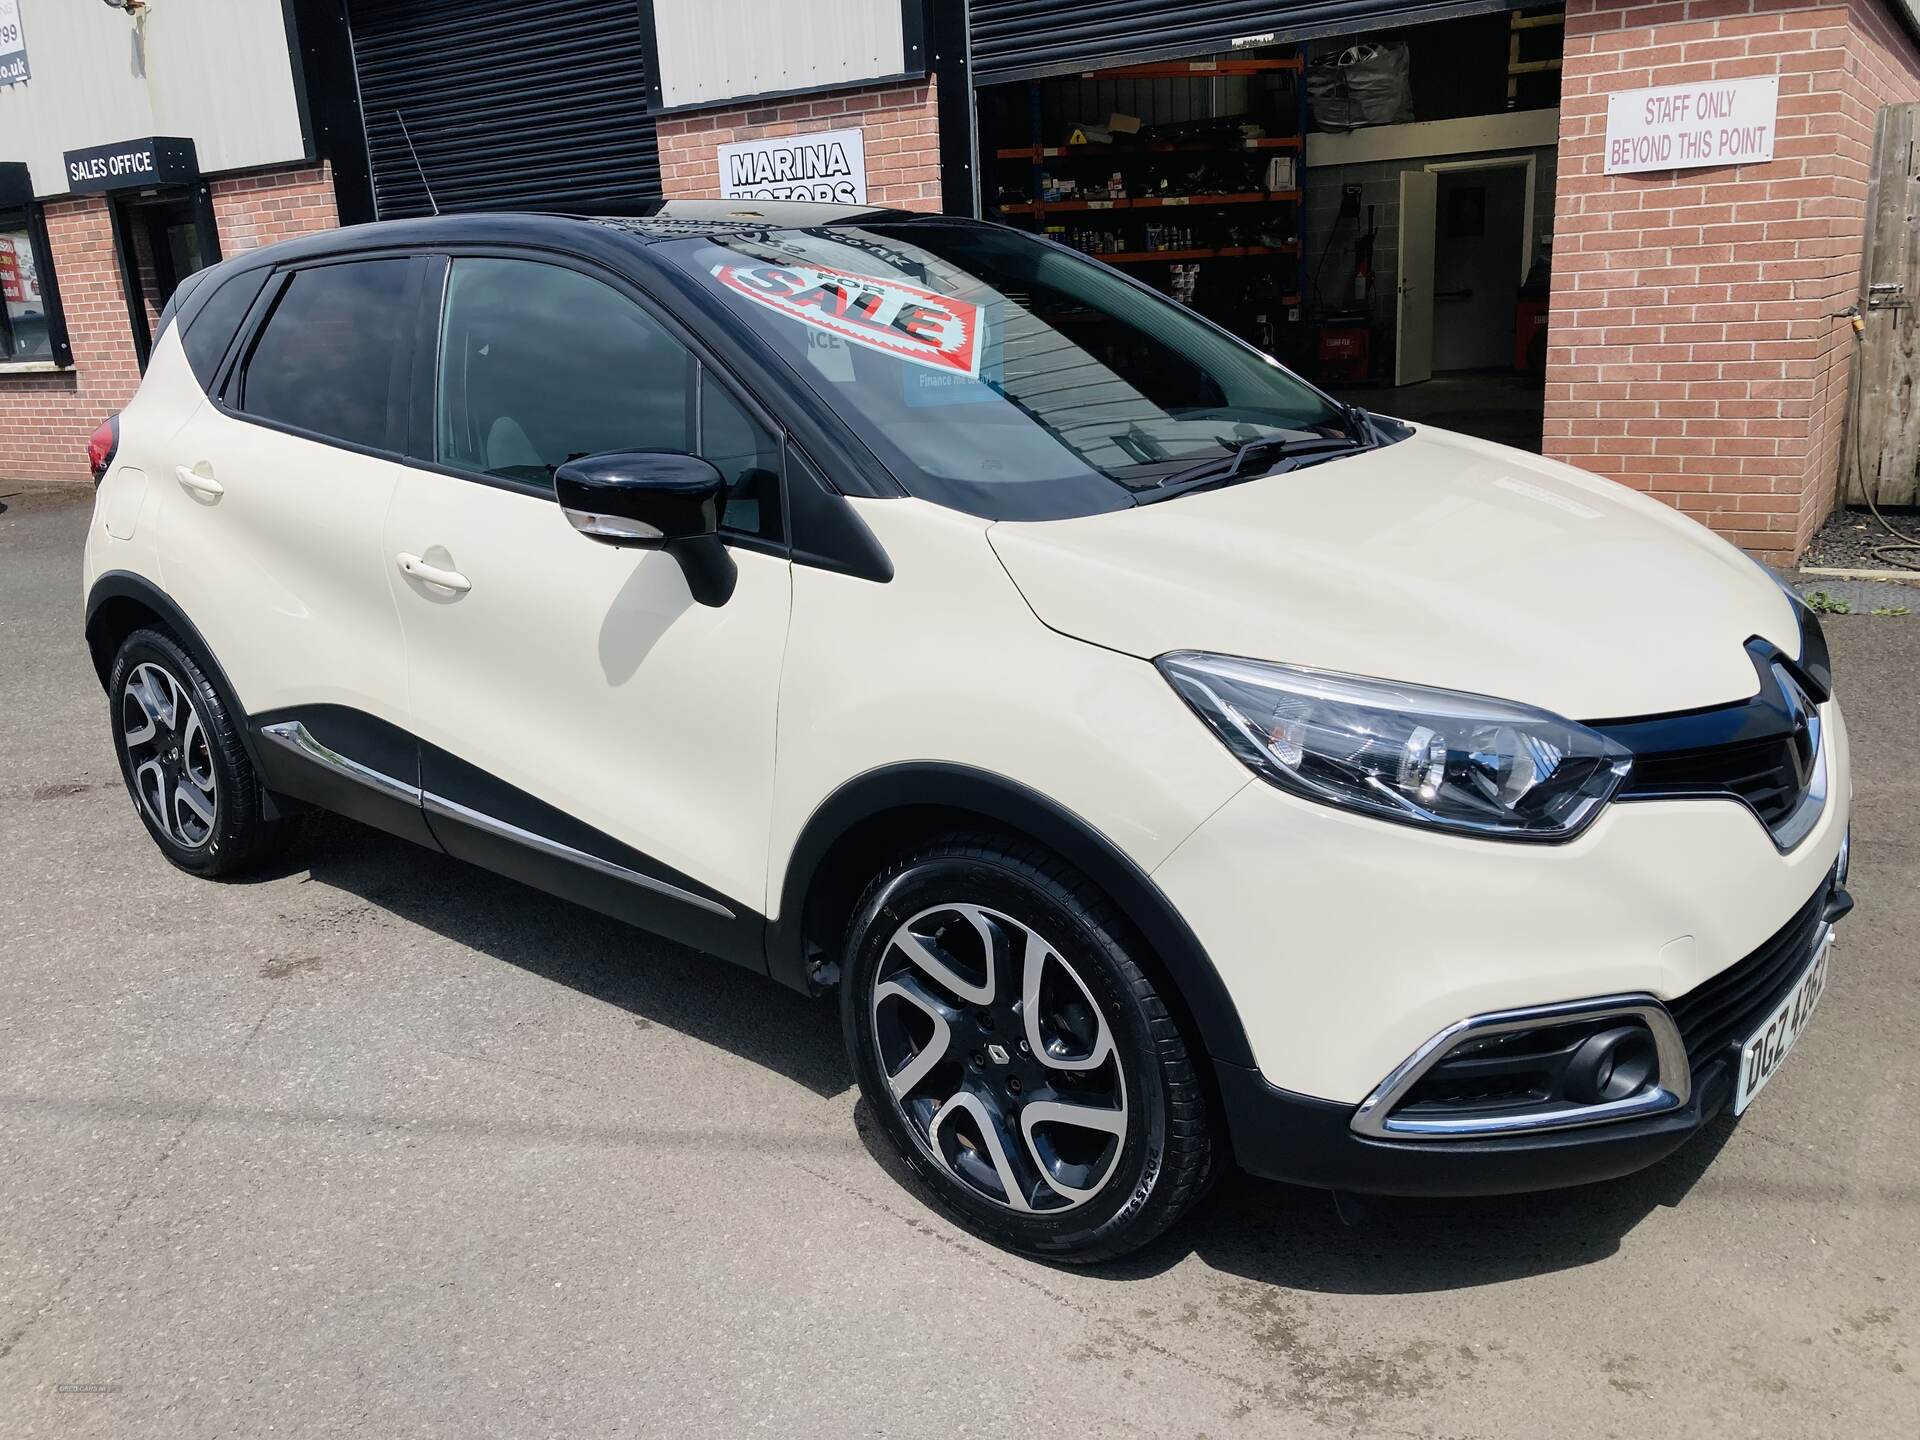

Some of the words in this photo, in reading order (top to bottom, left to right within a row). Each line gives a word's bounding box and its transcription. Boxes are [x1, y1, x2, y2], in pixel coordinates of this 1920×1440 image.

[0, 24, 17, 45] 99
[1645, 94, 1691, 125] STAFF
[1696, 90, 1736, 120] ONLY
[1611, 134, 1671, 166] BEYOND
[1679, 130, 1712, 159] THIS
[1719, 126, 1767, 156] POINT
[70, 158, 107, 181] SALES
[109, 152, 153, 175] OFFICE
[730, 143, 851, 186] MARINA
[817, 272, 886, 296] FOR
[737, 267, 954, 348] SALE
[920, 373, 952, 387] Finance
[1746, 1005, 1790, 1096] DGZ
